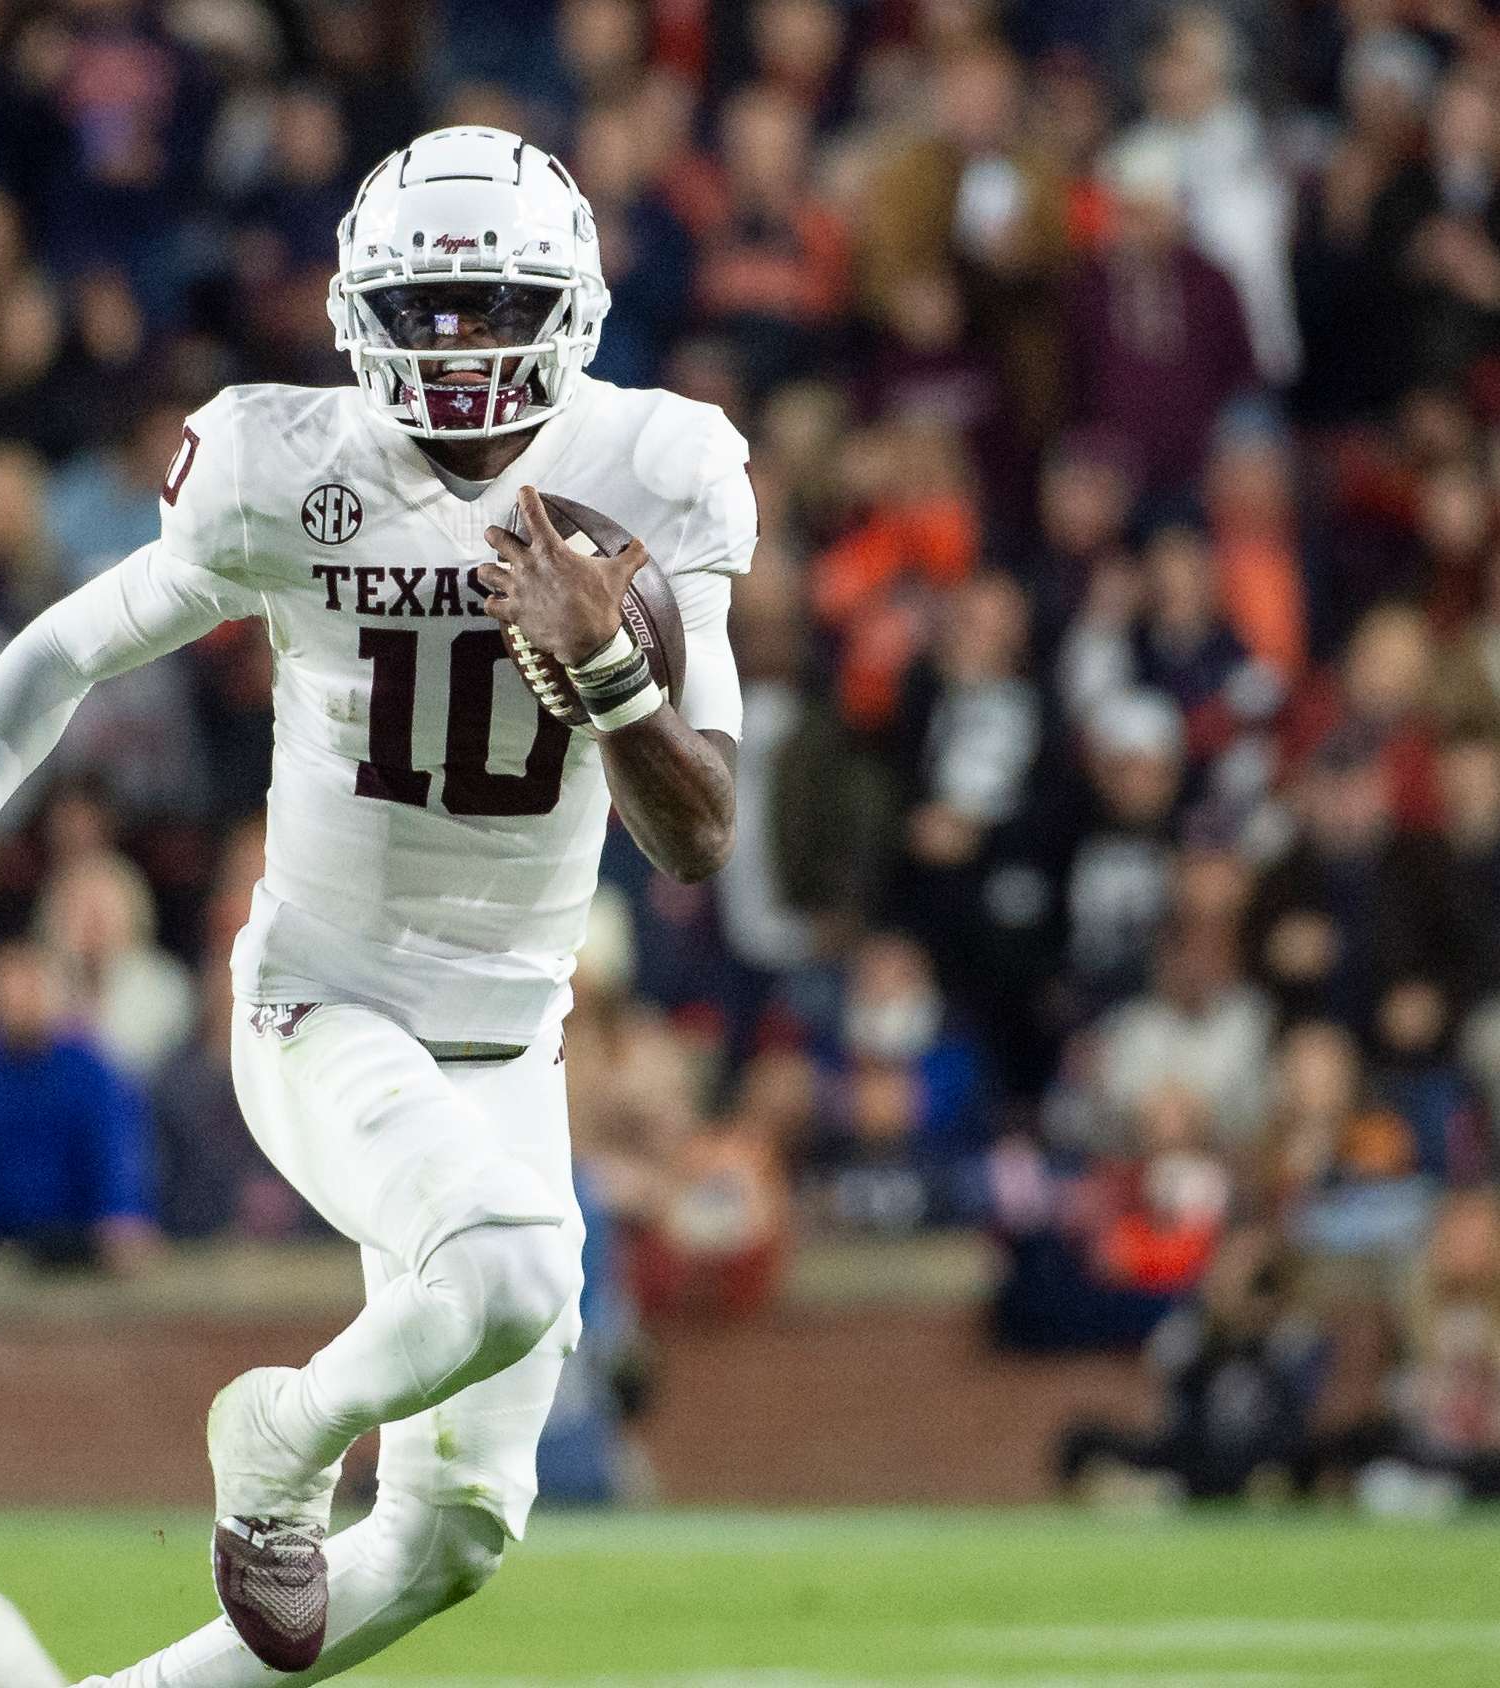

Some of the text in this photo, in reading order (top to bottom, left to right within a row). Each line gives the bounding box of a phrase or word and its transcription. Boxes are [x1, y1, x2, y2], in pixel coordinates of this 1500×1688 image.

[432, 233, 479, 255] Aggies
[304, 485, 361, 544] SEC
[355, 627, 573, 816] 10
